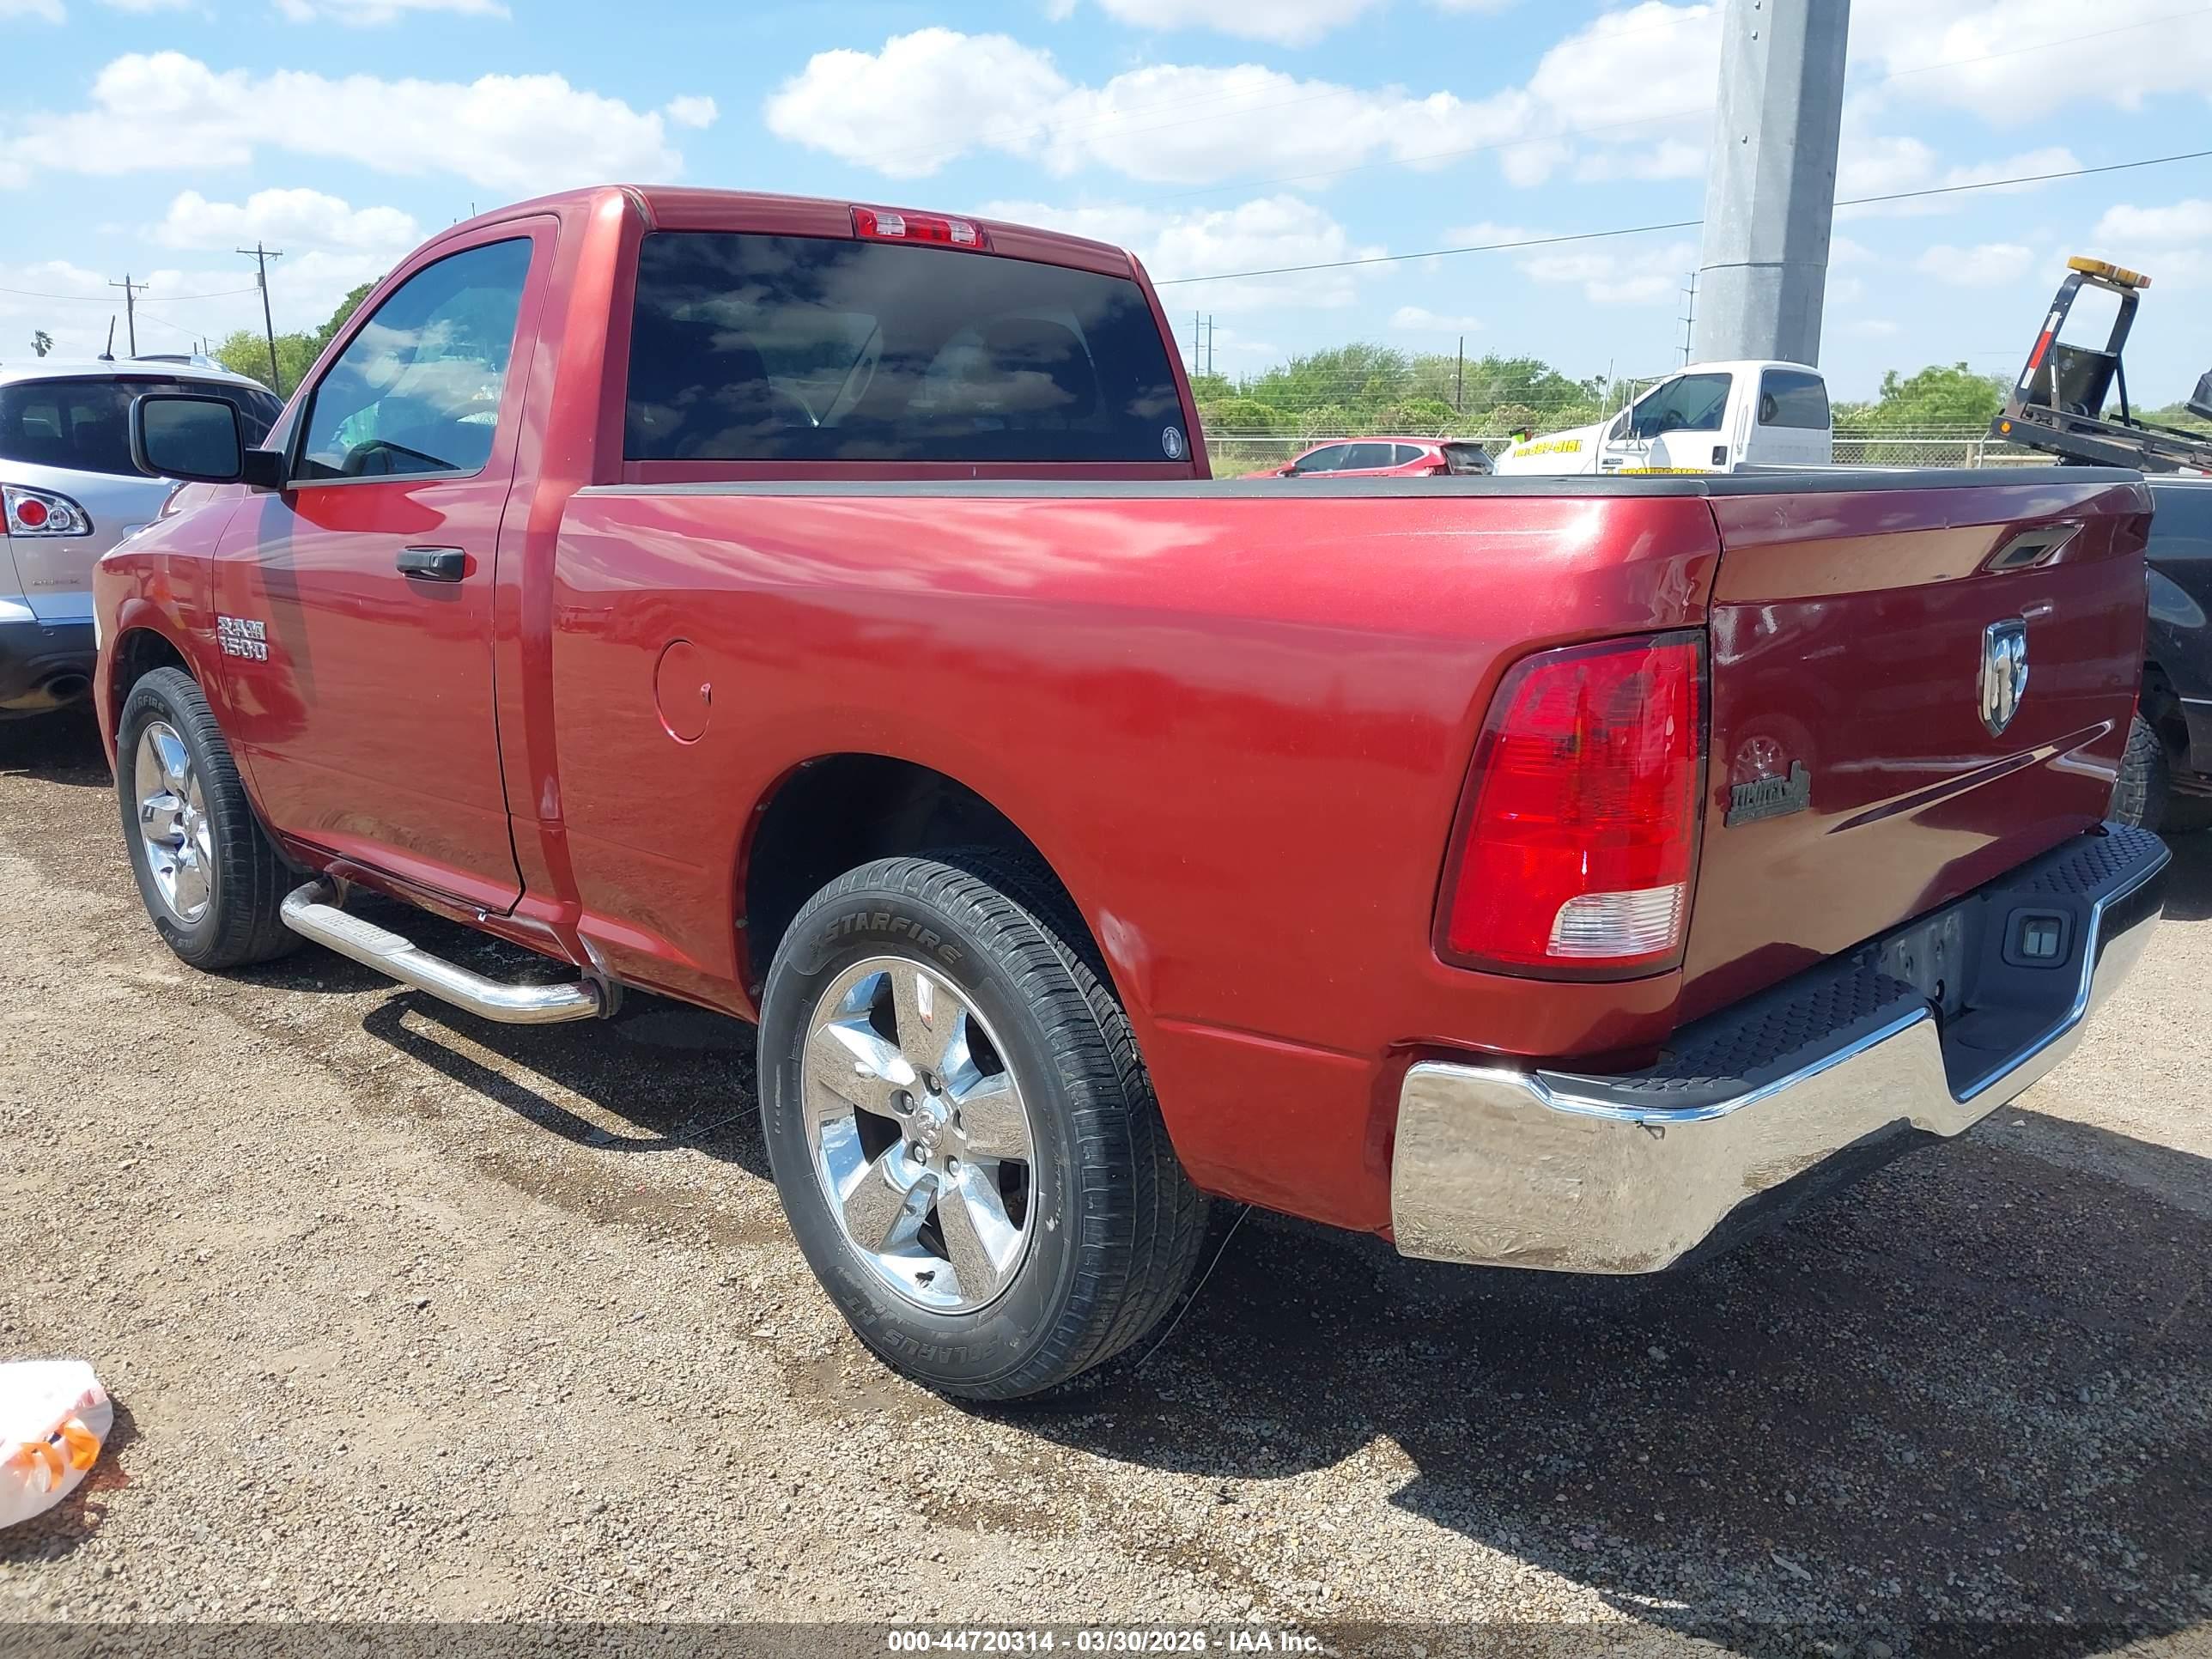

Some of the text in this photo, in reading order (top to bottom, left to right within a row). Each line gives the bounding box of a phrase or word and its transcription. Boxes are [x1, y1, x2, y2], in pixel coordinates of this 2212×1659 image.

[217, 616, 266, 641] RAM
[218, 636, 268, 661] 1500
[824, 912, 963, 965] STARFIRE
